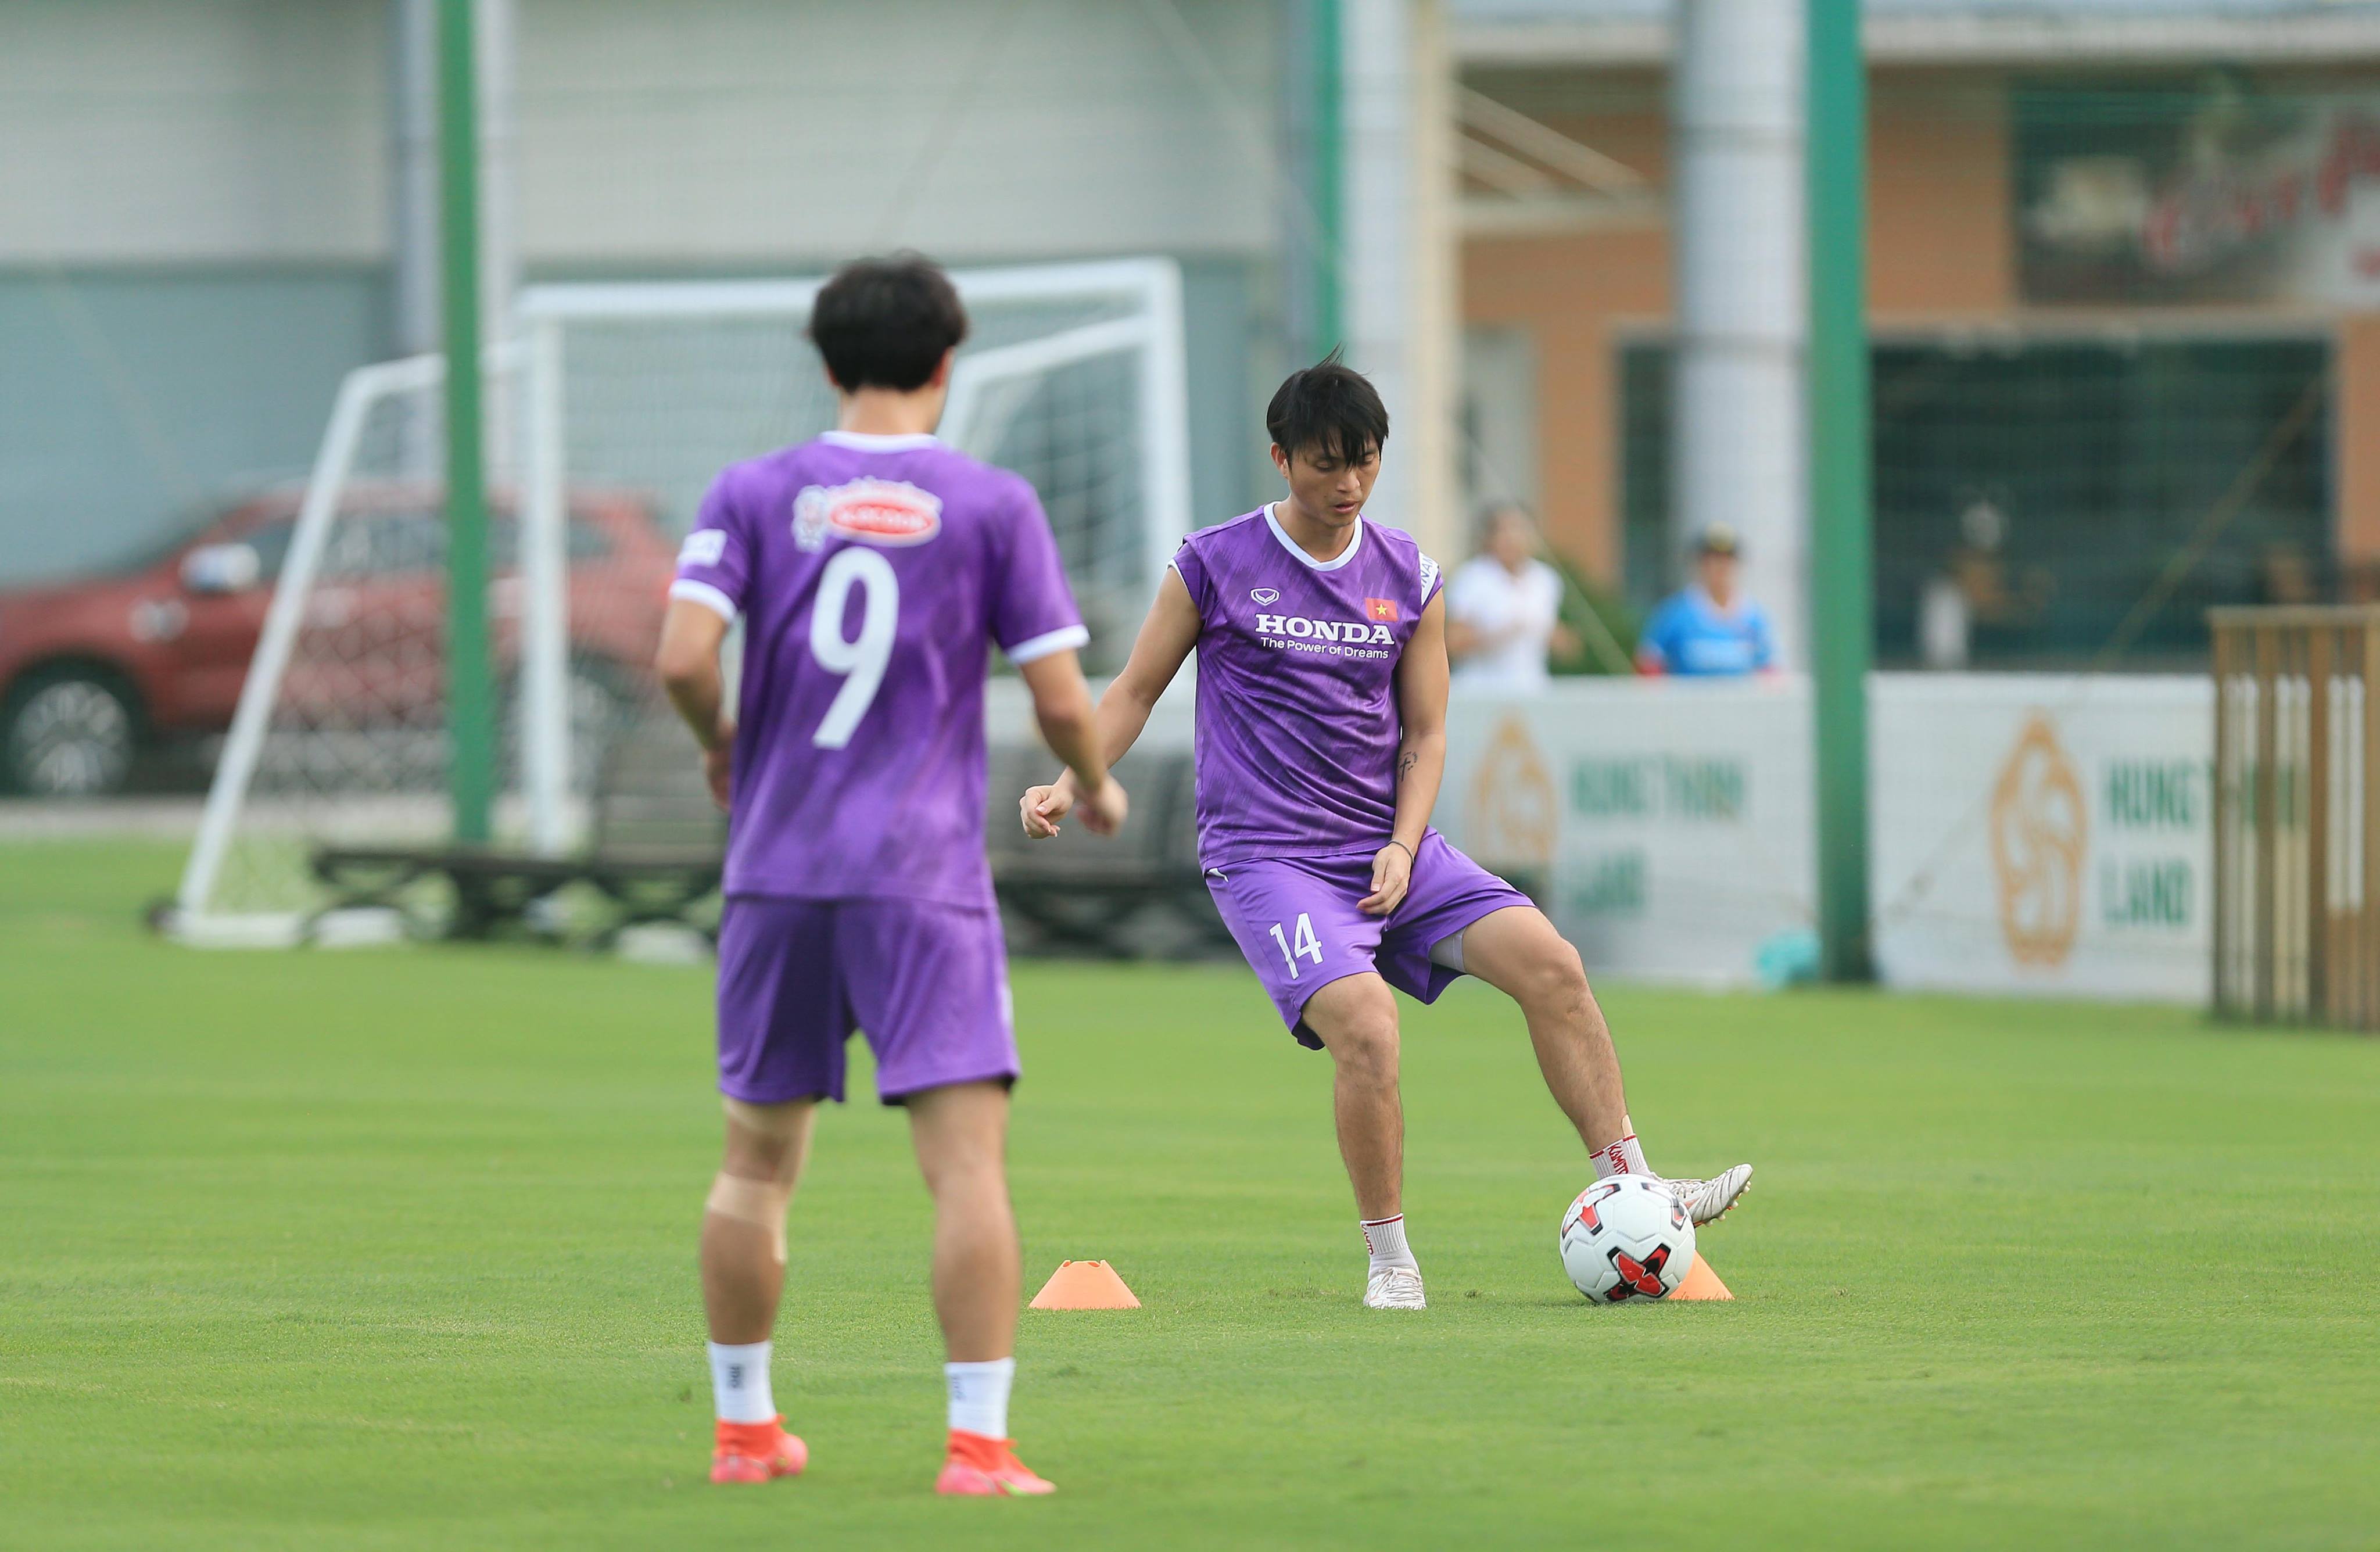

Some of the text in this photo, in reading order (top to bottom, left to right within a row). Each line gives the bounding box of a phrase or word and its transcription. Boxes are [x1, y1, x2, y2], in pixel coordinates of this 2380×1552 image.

[810, 546, 899, 748] 9
[1255, 614, 1395, 645] HONDA
[1260, 636, 1389, 659] The Power of Dreams
[1269, 912, 1324, 980] 14
